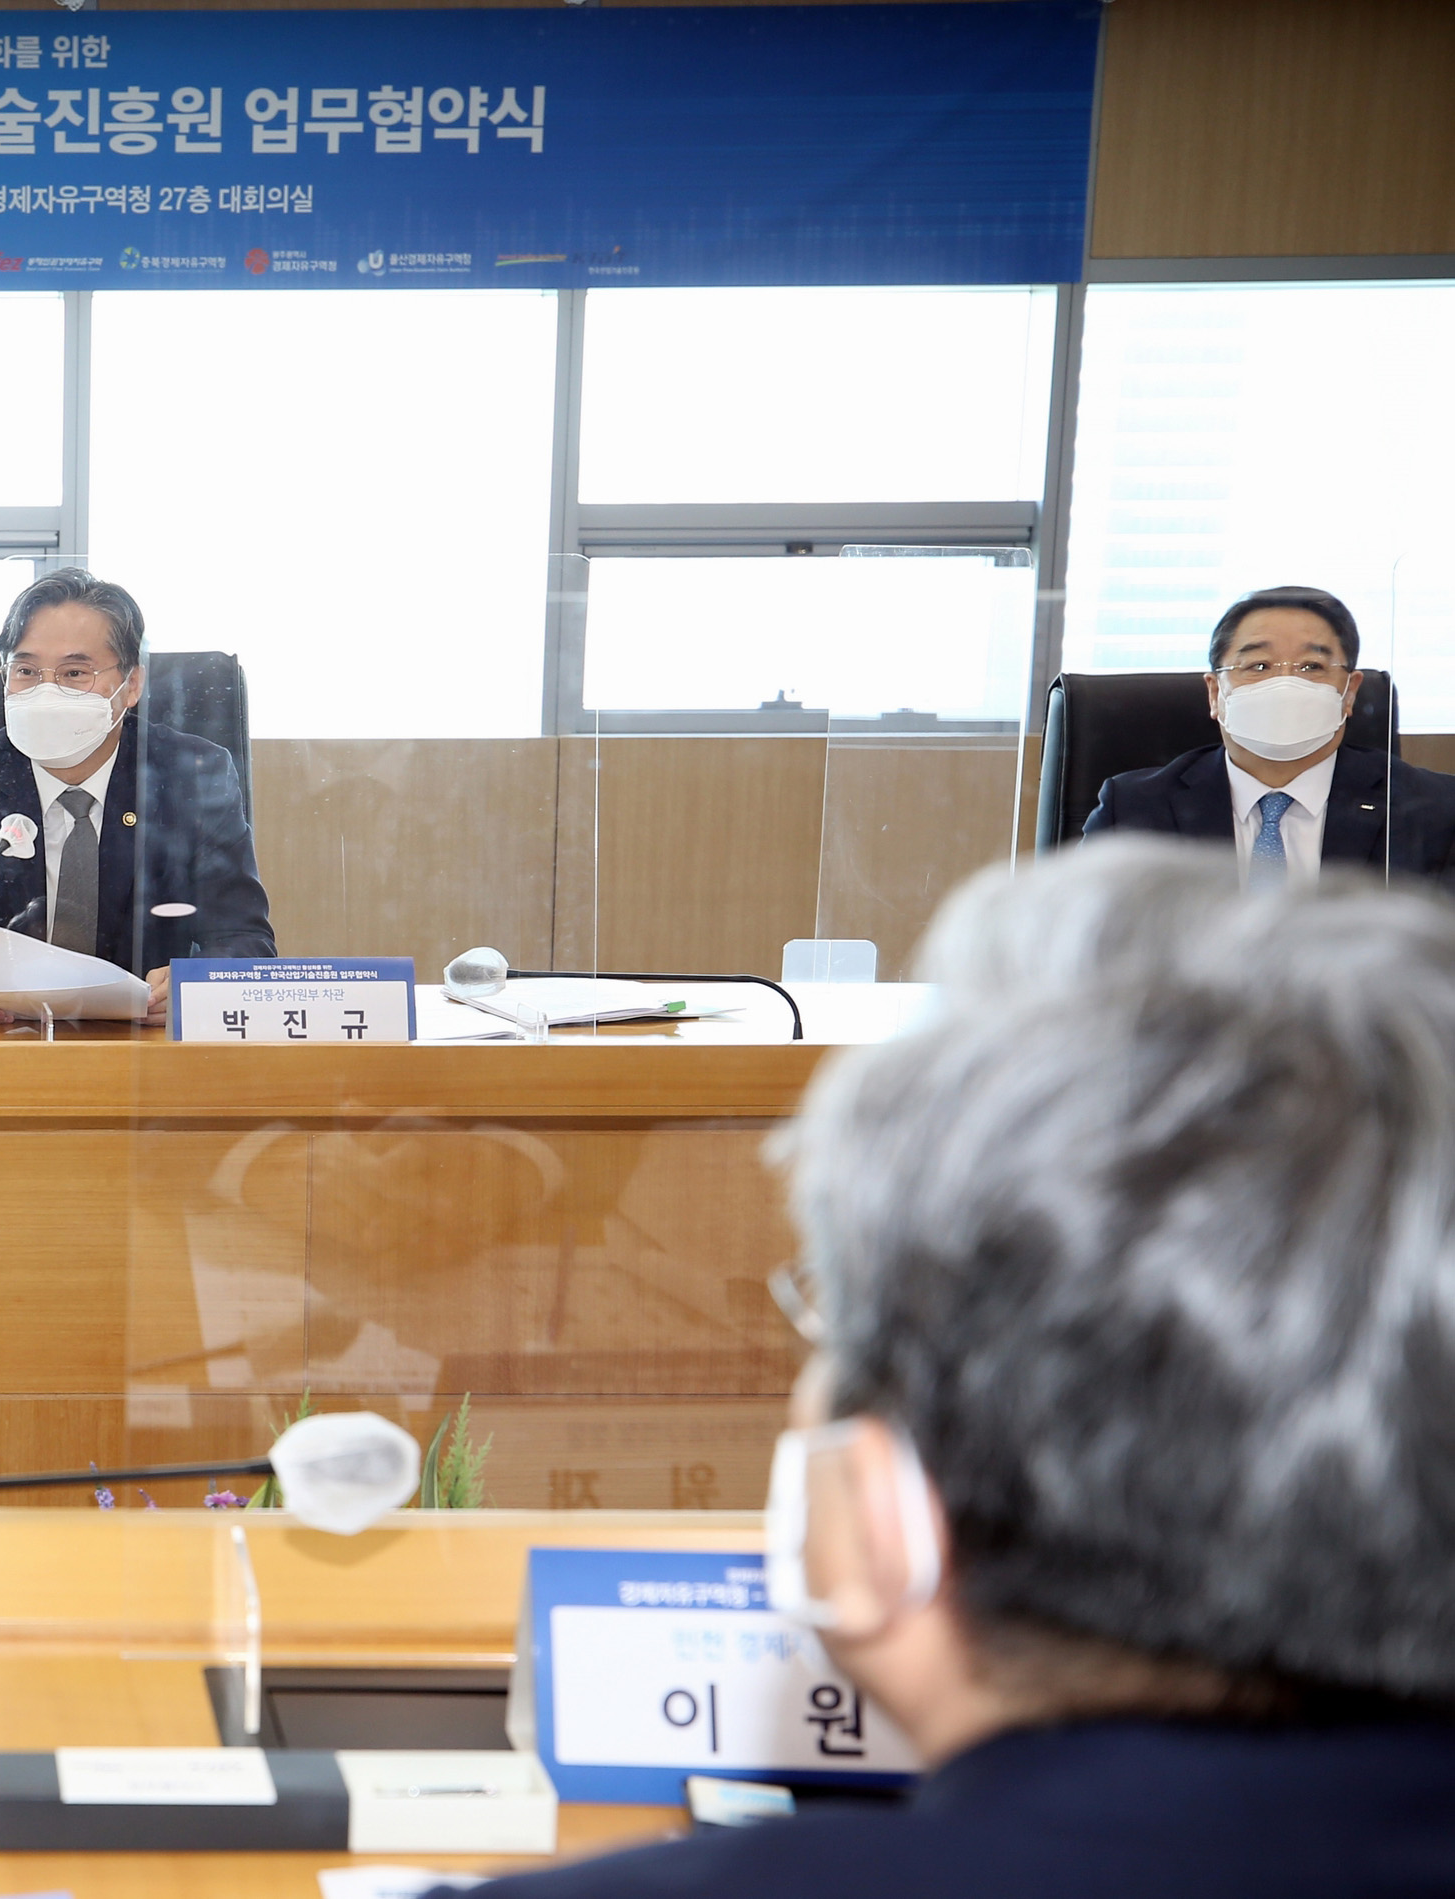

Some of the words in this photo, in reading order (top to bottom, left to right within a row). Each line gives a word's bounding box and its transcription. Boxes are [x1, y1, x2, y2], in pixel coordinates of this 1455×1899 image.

[52, 36, 111, 69] 위한
[244, 86, 546, 154] 업무협약식
[158, 186, 212, 213] 27층
[218, 185, 313, 213] 대회의실
[141, 256, 226, 269] 충북경제자유구역청
[272, 260, 338, 273] 경제자유구역청
[389, 253, 472, 267] 울산경제자유구역청
[208, 971, 262, 980] 경제자유구역청
[270, 970, 338, 979] 한국산업기술진흥원
[339, 970, 378, 979] 업무협약식
[241, 988, 320, 1001] 산업통상자원부
[322, 988, 346, 1001] 차관
